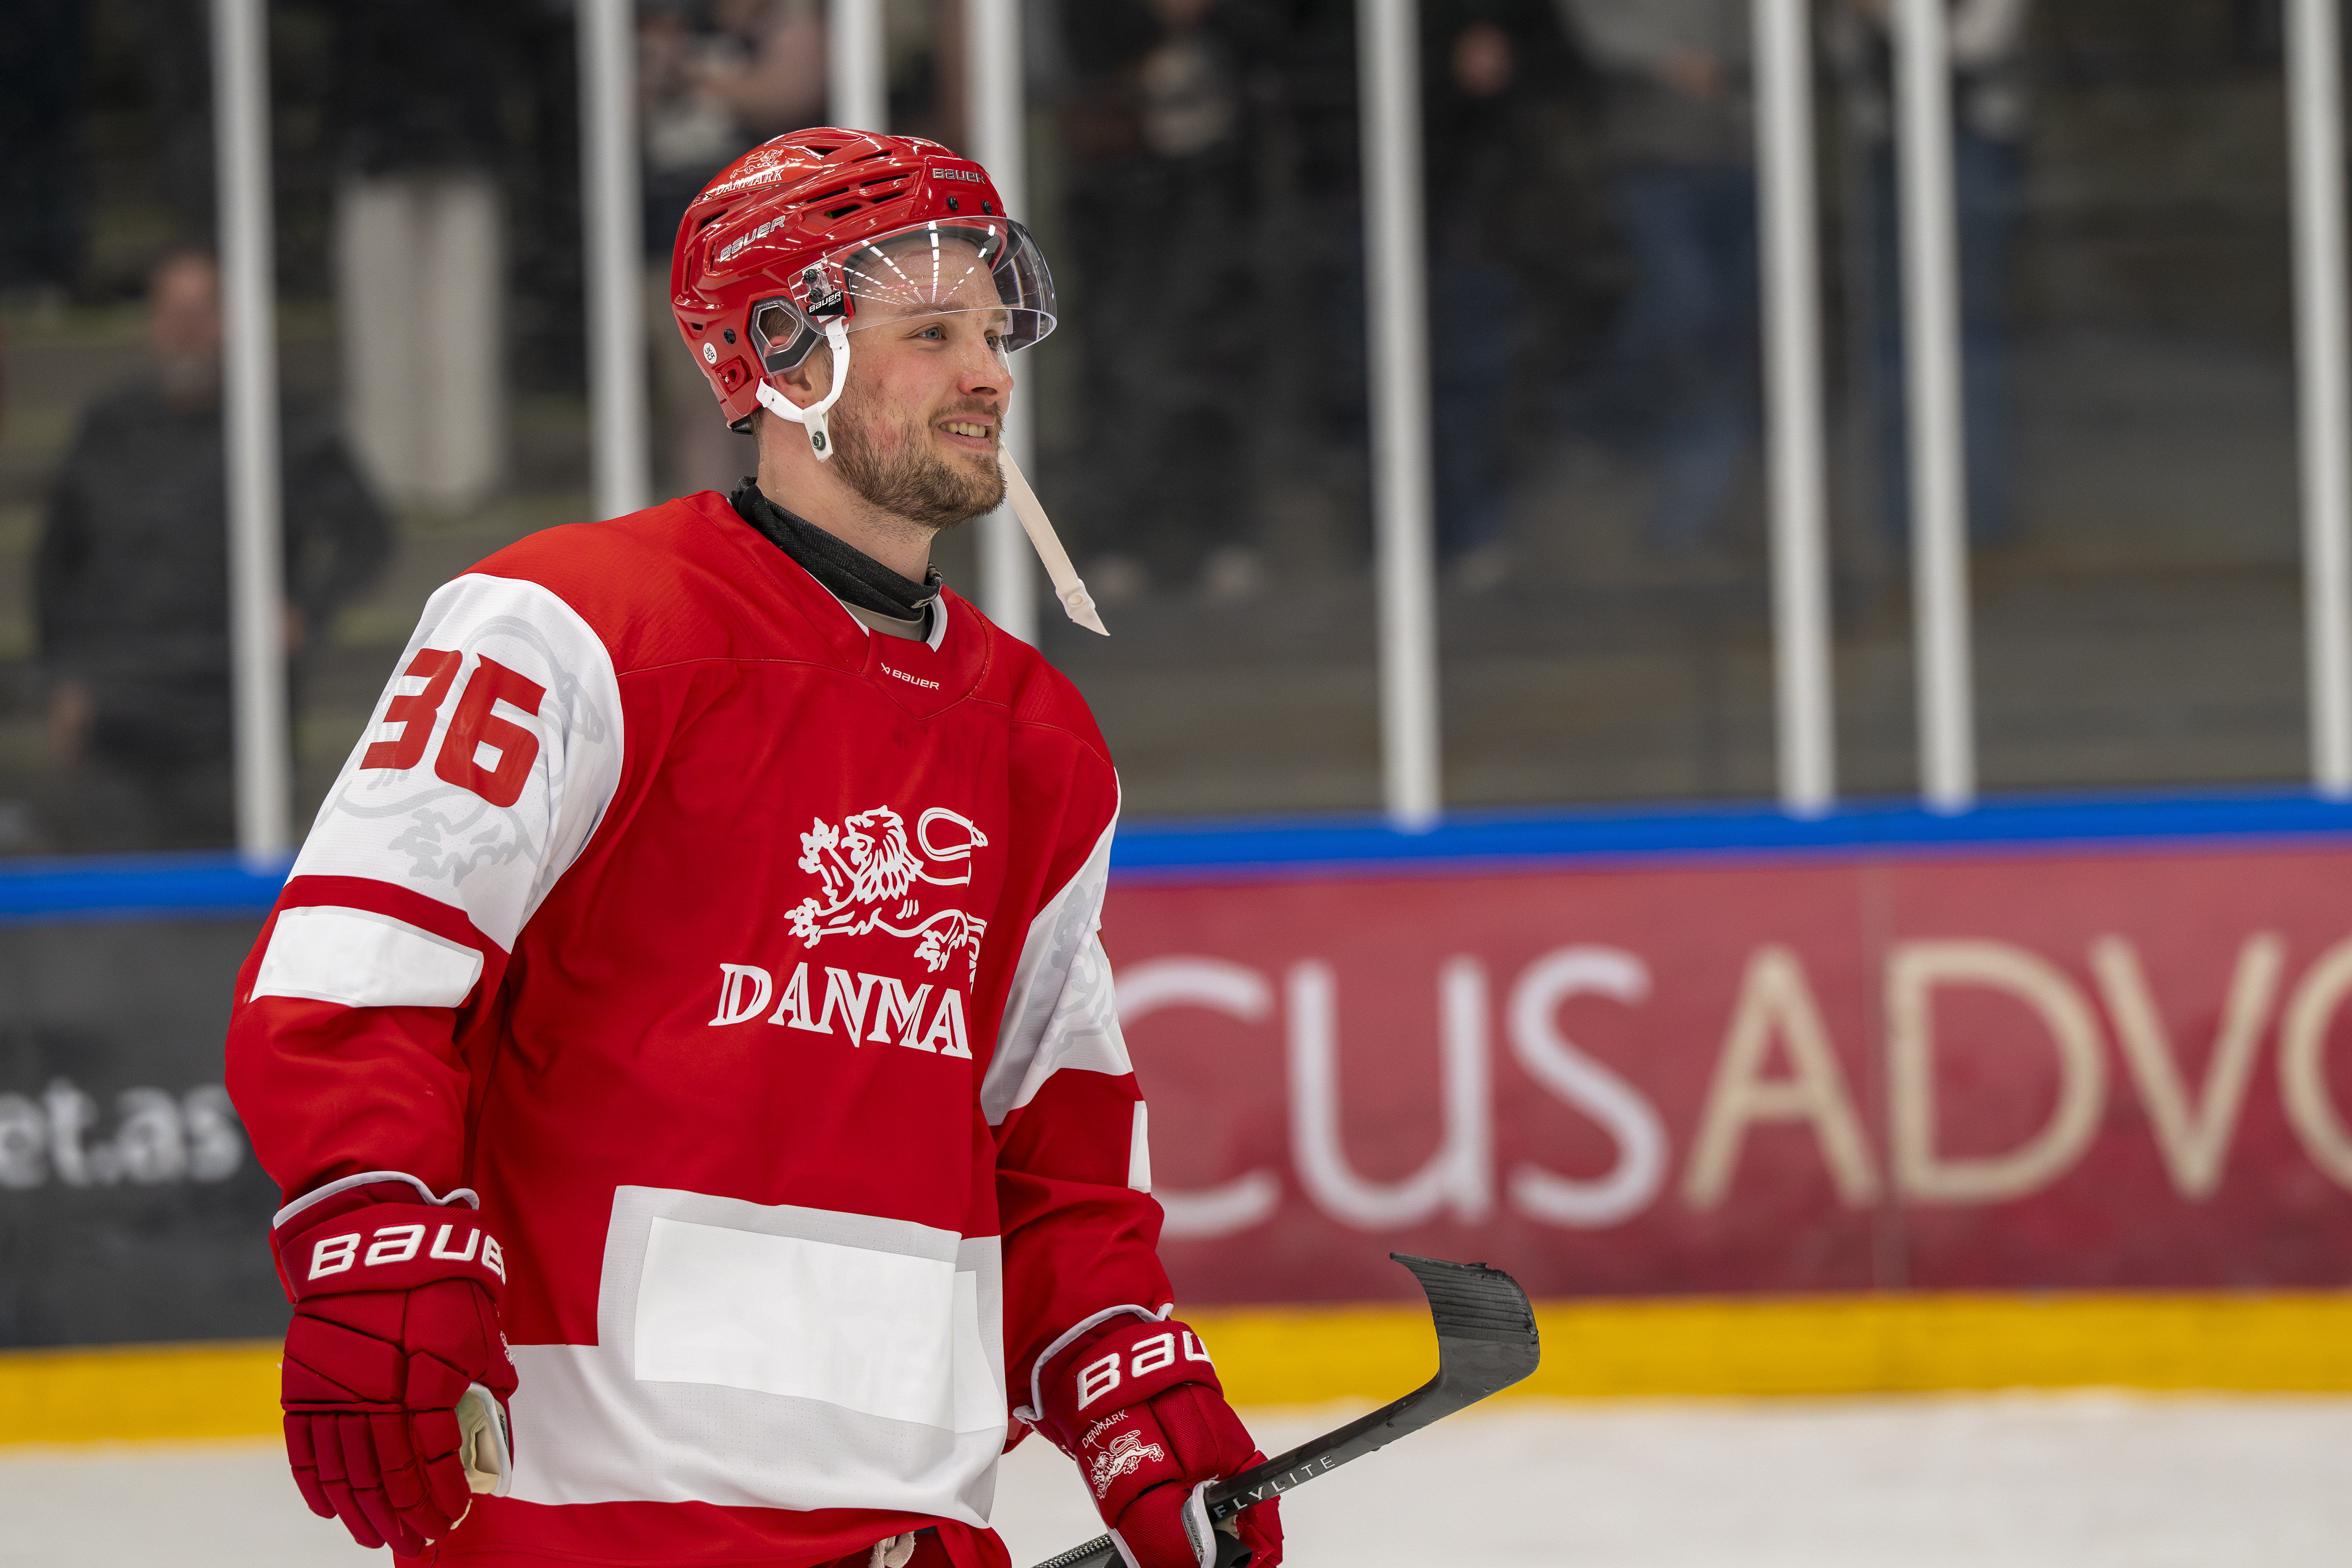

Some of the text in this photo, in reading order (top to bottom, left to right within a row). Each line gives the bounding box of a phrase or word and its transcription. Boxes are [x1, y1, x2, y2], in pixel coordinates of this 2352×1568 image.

[715, 169, 785, 196] DANMARK
[704, 345, 712, 354] UK
[707, 352, 715, 361] CA
[359, 648, 547, 808] 36
[708, 962, 973, 1060] DANMA
[309, 1224, 506, 1285] BAUE
[1077, 1331, 1215, 1411] BAU
[1082, 1409, 1129, 1449] DENMARK
[1213, 1455, 1336, 1518] FLYLITE
